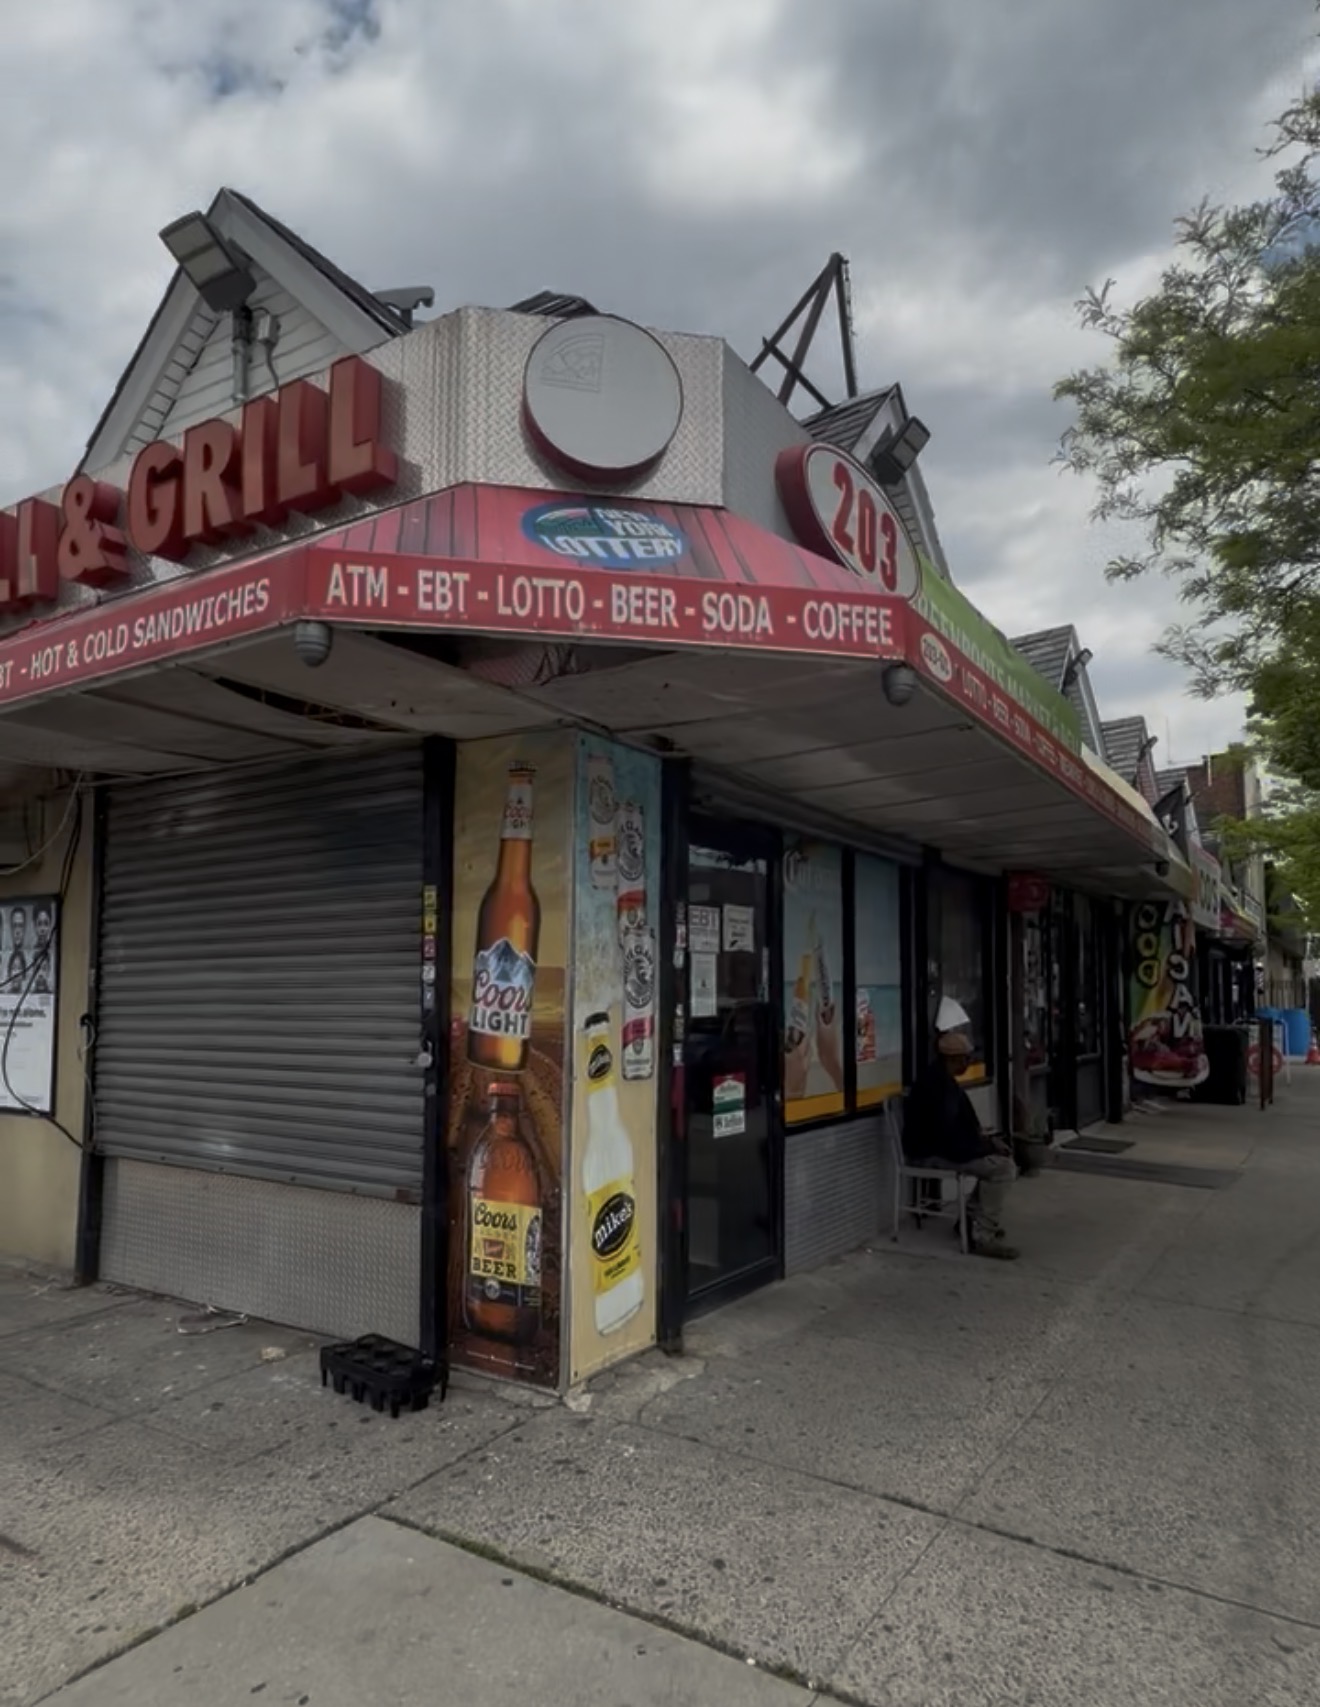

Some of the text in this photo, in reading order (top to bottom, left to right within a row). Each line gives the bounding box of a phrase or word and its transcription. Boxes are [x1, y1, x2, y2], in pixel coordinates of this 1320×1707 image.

[58, 473, 122, 583] &
[128, 354, 392, 556] GRILL
[603, 519, 674, 538] YORK
[832, 461, 898, 592] 203
[539, 535, 683, 559] LOTTERY
[326, 563, 388, 608] ATM
[417, 569, 470, 613] EBT
[497, 574, 585, 621] LOTTO
[611, 583, 680, 628] BEER
[702, 591, 774, 636] SODA
[803, 600, 894, 646] COFFEE
[30, 644, 64, 680] HOT
[66, 640, 79, 670] &
[83, 626, 128, 664] COLD
[132, 578, 271, 649] SANDWICHES
[472, 968, 533, 1013] Coors
[472, 1006, 528, 1035] LIGHT
[474, 1201, 518, 1231] Coors
[472, 1256, 517, 1279] BEER
